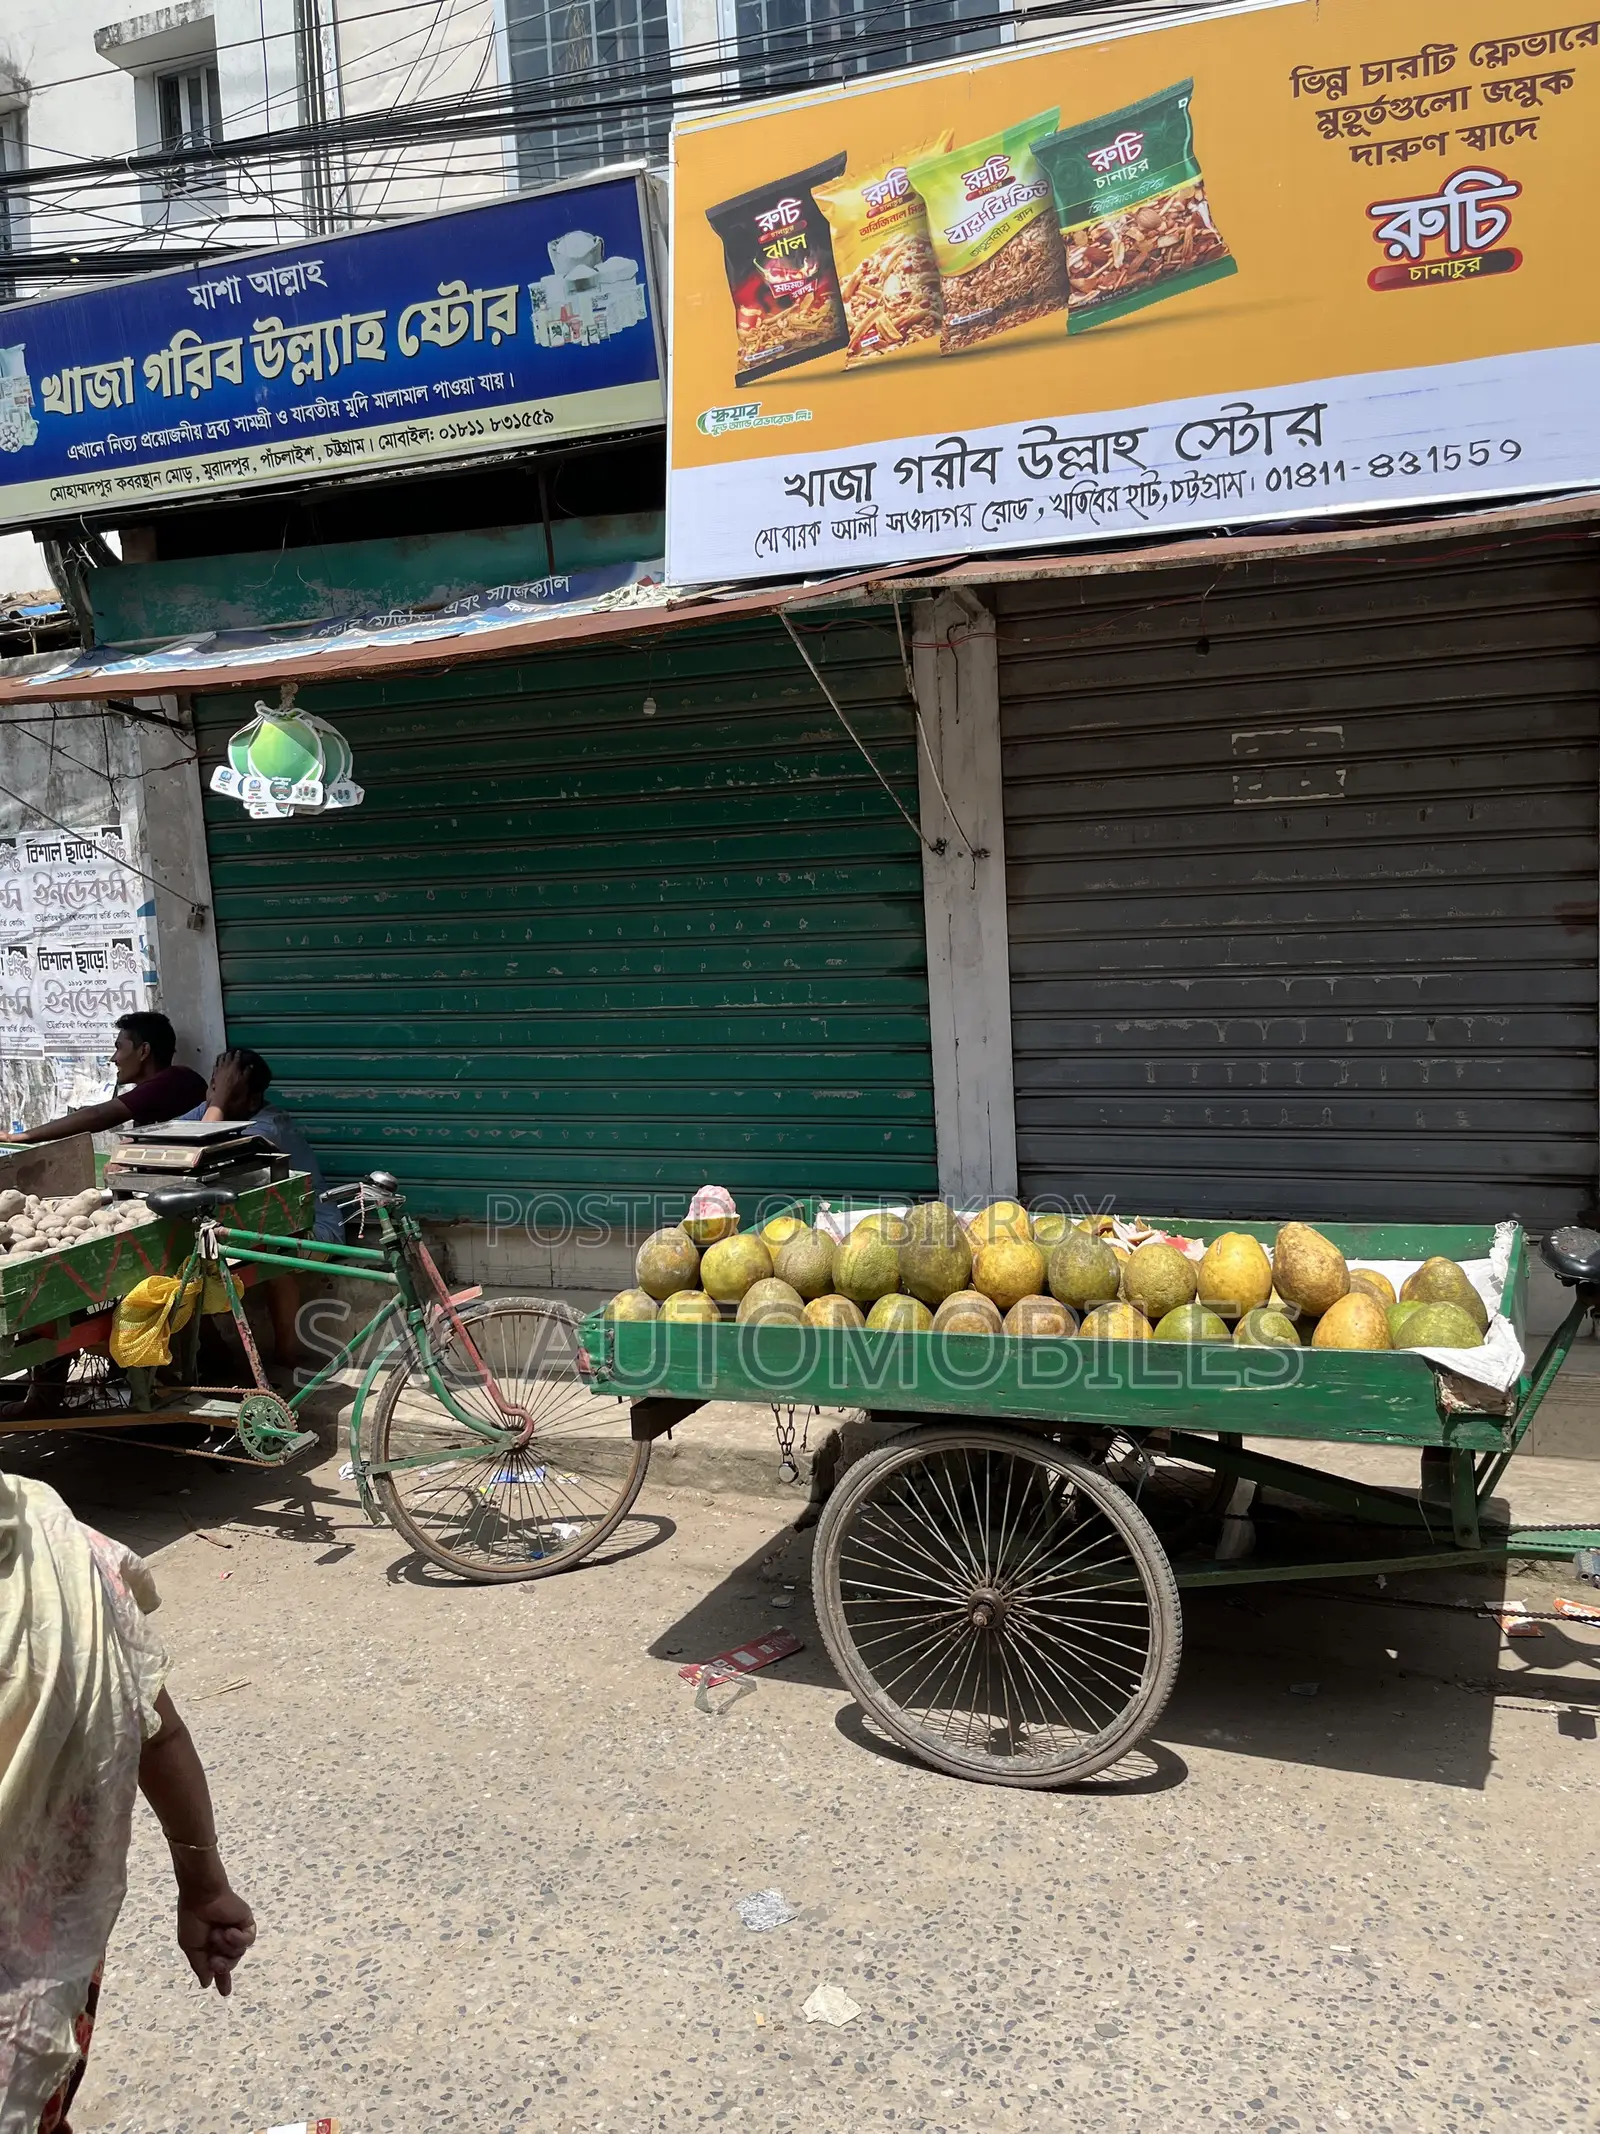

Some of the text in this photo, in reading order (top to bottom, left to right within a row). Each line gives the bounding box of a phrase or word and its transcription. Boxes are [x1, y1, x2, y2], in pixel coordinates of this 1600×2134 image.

[1289, 65, 1351, 100] ভিন্ন
[1360, 43, 1458, 86] চারটি
[1315, 68, 1576, 140] মুহূর্তগুলো জমুক
[1087, 132, 1144, 172] রুচি
[1349, 117, 1540, 167] দারুণ স্বাদে
[861, 167, 910, 207] রুচি
[961, 155, 1011, 190] রুচি
[1093, 158, 1149, 188] চানাচুর
[755, 198, 802, 232] রুচি
[859, 210, 907, 236] অরিজিনাল
[1368, 168, 1520, 260] রুচি
[763, 233, 807, 258] ঝাল
[187, 260, 328, 310] মাশা আল্লাহ
[1408, 256, 1482, 281] চানাচুর
[40, 356, 135, 416] খাজা
[143, 329, 244, 400] গরিব
[397, 279, 520, 358] ষ্টোর
[67, 441, 106, 461] এখানে
[107, 433, 137, 454] নিত্য
[140, 419, 203, 449] প্রয়োজনীয়
[205, 419, 231, 440] দ্রব্য
[232, 406, 273, 432] সামগ্রী
[275, 409, 289, 425] ও
[291, 397, 340, 424] যাবতীয়
[343, 391, 370, 419] মুদি
[371, 384, 430, 411] মালামাল
[432, 376, 476, 400] পাওয়া
[49, 478, 113, 502] মোহাম্মদপুর
[115, 471, 162, 491] কবরস্থান
[439, 418, 485, 440] ০১৮১১
[489, 407, 554, 433] ৮৩১৫৫৯
[783, 402, 1328, 507] খাজা গরীব উল্লাহ স্টোর
[831, 504, 880, 541] আলী
[886, 502, 977, 534] সওদাগর
[444, 594, 480, 615] এবং
[26, 840, 62, 864] বিশাল
[37, 946, 73, 972] বিশাল
